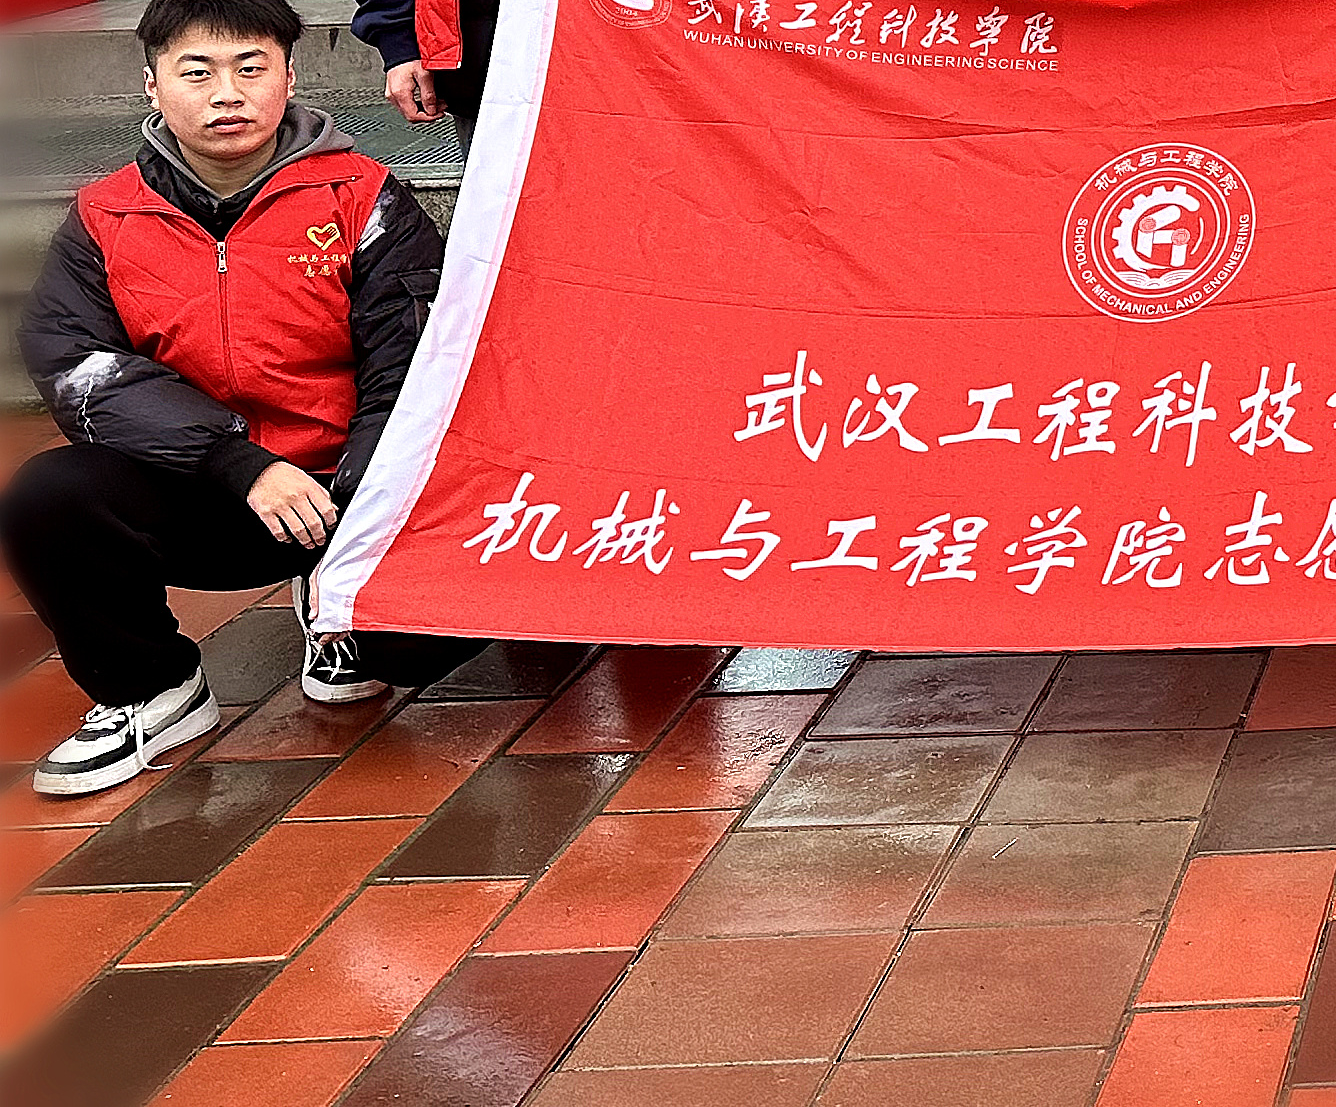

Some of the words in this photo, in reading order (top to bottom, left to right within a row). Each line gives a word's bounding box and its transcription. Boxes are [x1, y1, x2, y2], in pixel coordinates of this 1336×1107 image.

[683, 29, 745, 48] WUHAN
[747, 38, 844, 59] UNIVERSITY
[847, 50, 868, 62] OF
[871, 53, 986, 70] ENGINEERING
[987, 57, 1060, 72] SCIENCE
[1094, 149, 1240, 196] 机械与工程学院
[1073, 217, 1089, 270] SCHOOL
[1081, 270, 1097, 285] OF
[1091, 283, 1173, 316] MECHANICAL
[1174, 290, 1203, 311] AND
[1202, 213, 1250, 294] ENGINEERING
